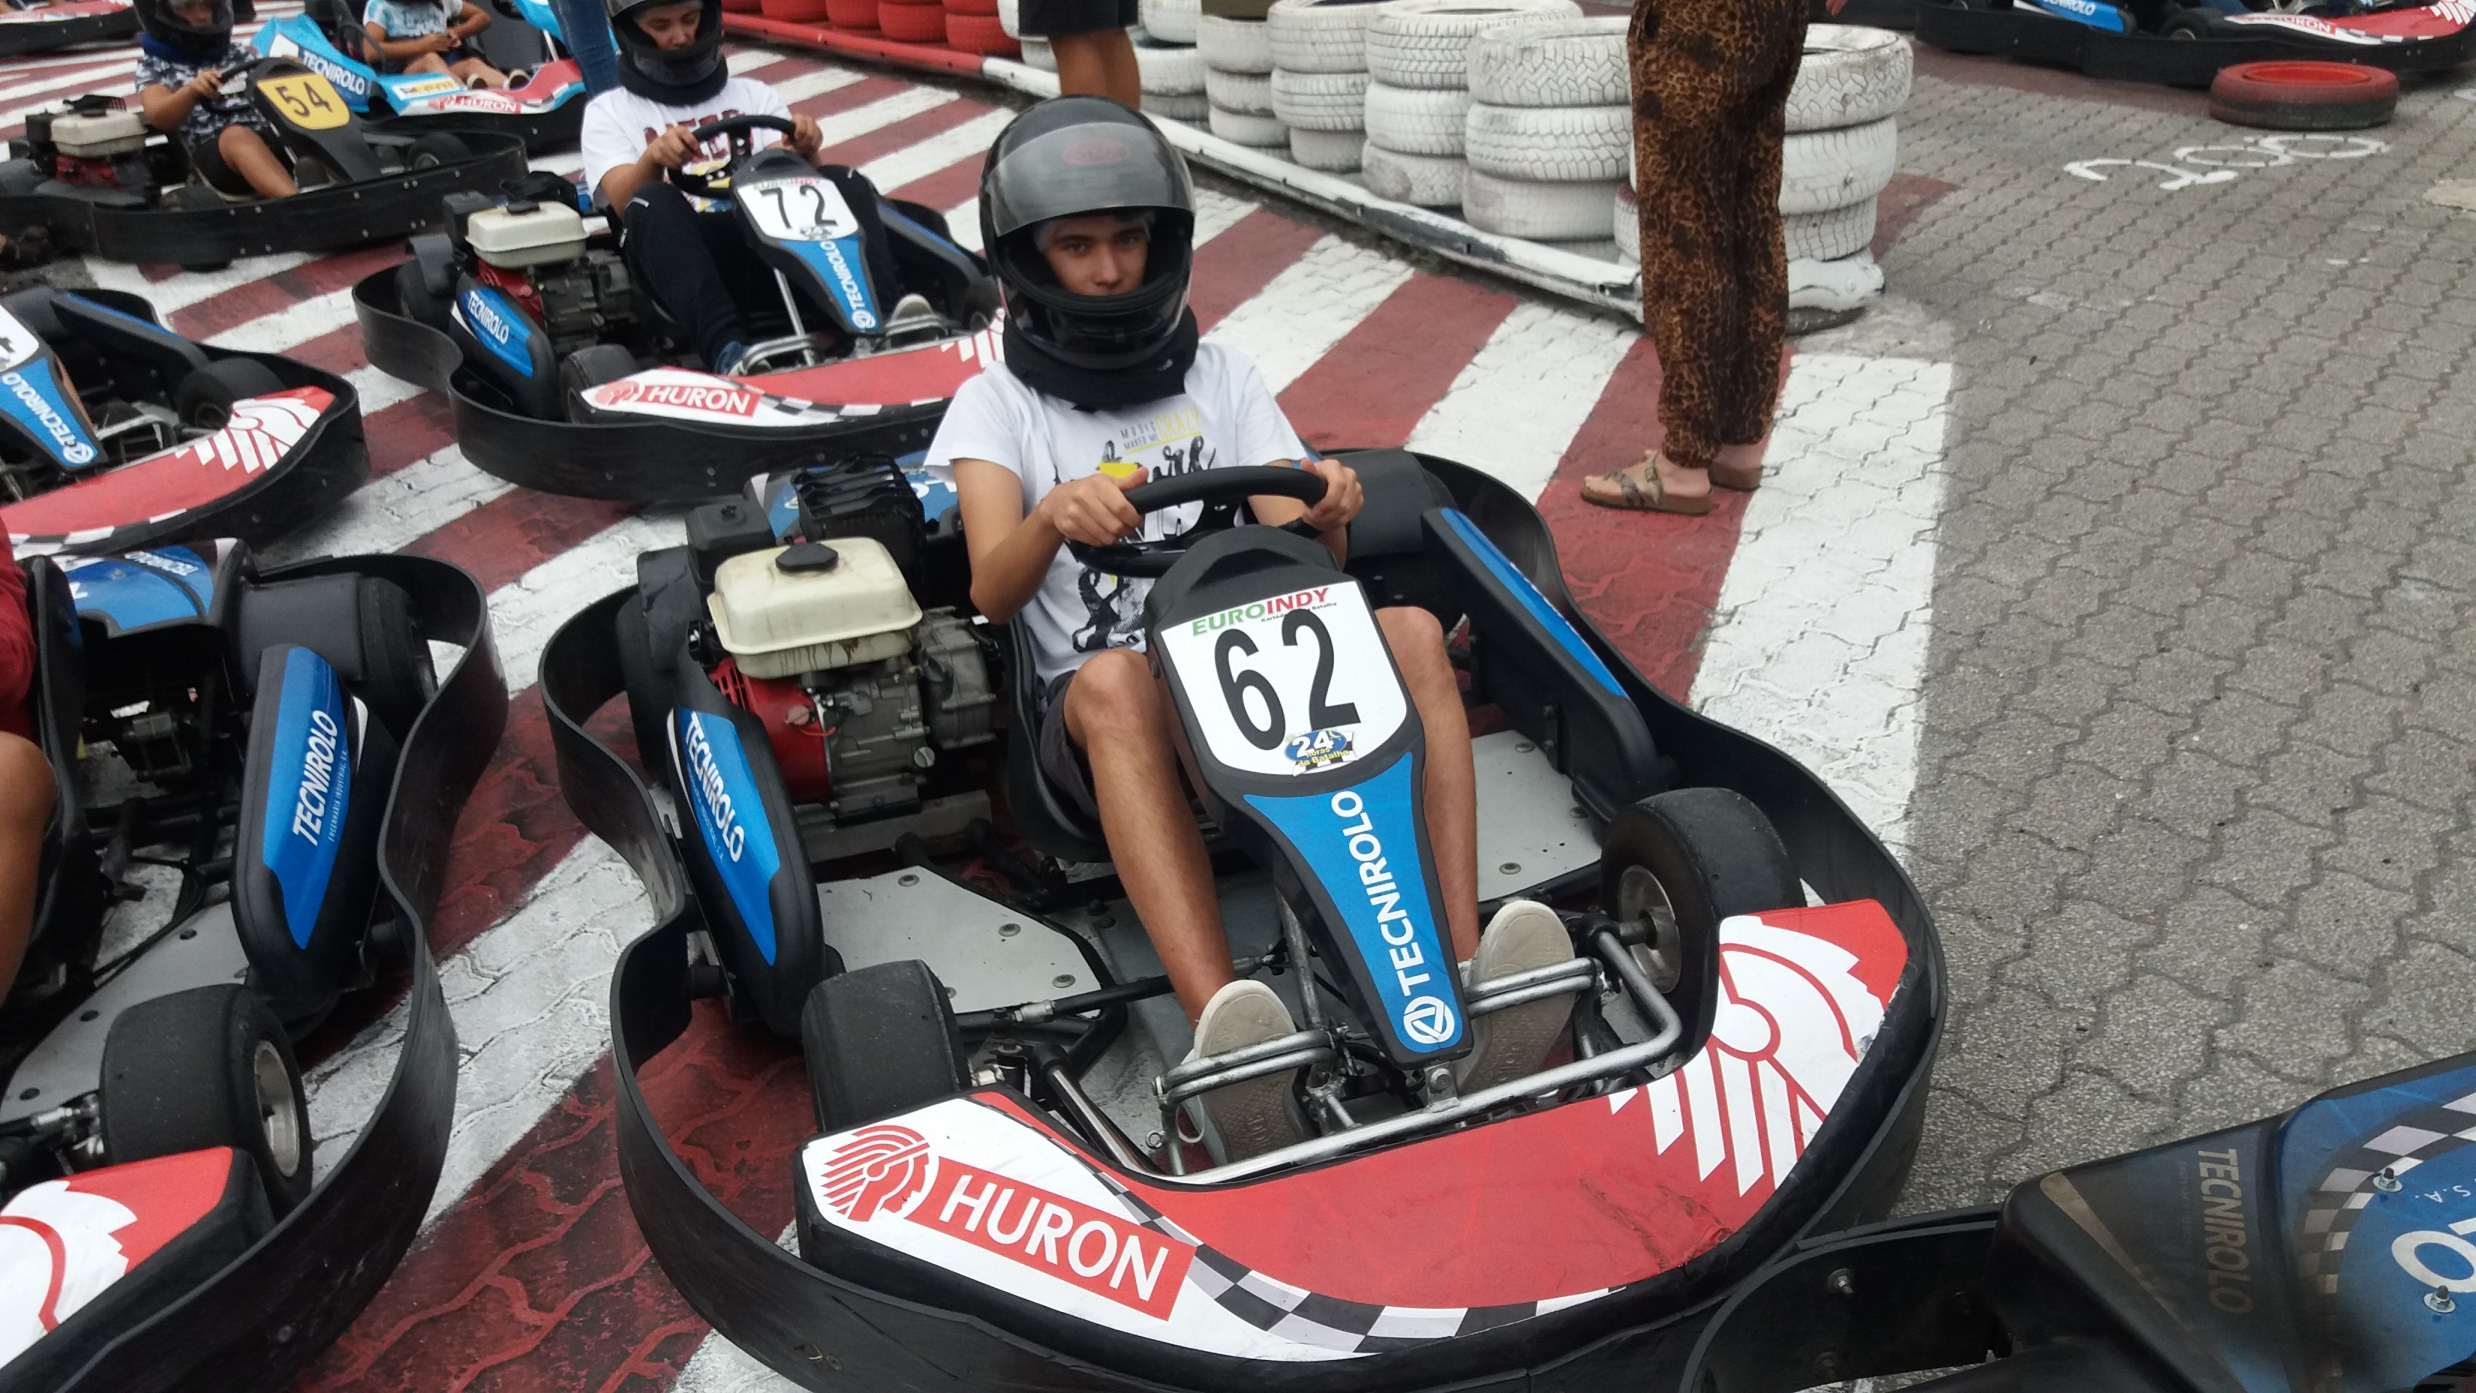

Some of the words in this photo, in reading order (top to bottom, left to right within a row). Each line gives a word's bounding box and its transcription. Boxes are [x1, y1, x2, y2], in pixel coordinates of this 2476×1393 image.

[274, 82, 333, 118] 54
[303, 51, 366, 95] TECNIROLO
[759, 184, 838, 230] 72
[820, 240, 866, 311] TECNIROLO
[467, 290, 509, 344] TECNIROLO
[648, 385, 751, 415] HURON
[1192, 587, 1329, 637] EUROINDY
[1214, 608, 1361, 750] 62
[1292, 729, 1334, 757] 24
[293, 709, 338, 847] TECNIROLO
[684, 711, 744, 862] TECNIROLO
[1331, 790, 1431, 997] TECNIROLO
[939, 1174, 1168, 1302] HURON
[2197, 1148, 2258, 1315] TECNIROLO
